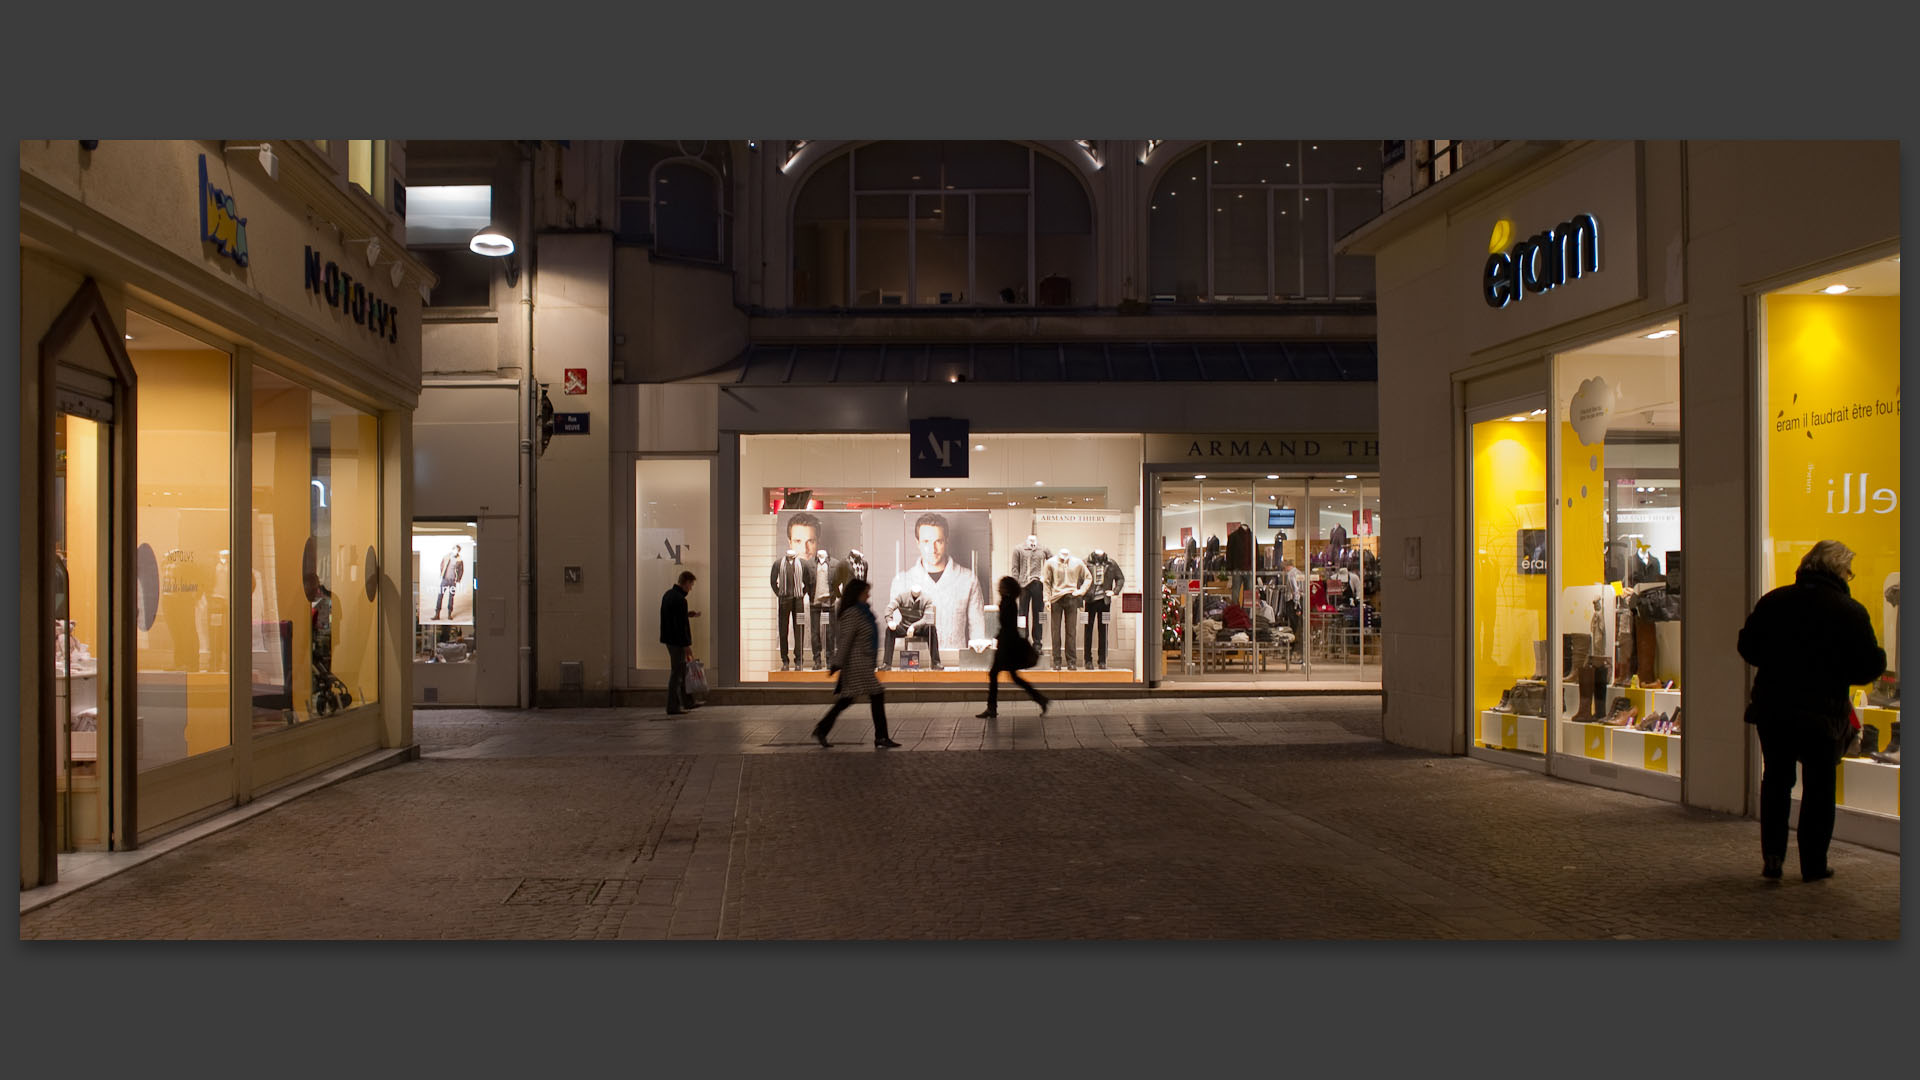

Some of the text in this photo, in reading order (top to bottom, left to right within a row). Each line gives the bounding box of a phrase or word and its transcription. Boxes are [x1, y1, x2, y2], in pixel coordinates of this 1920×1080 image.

[1484, 213, 1599, 308] éram
[1803, 413, 1808, 428] il
[1811, 405, 1849, 426] faudrait
[1852, 402, 1873, 420] être
[1876, 399, 1894, 416] fou
[1188, 440, 1321, 457] ARMAND
